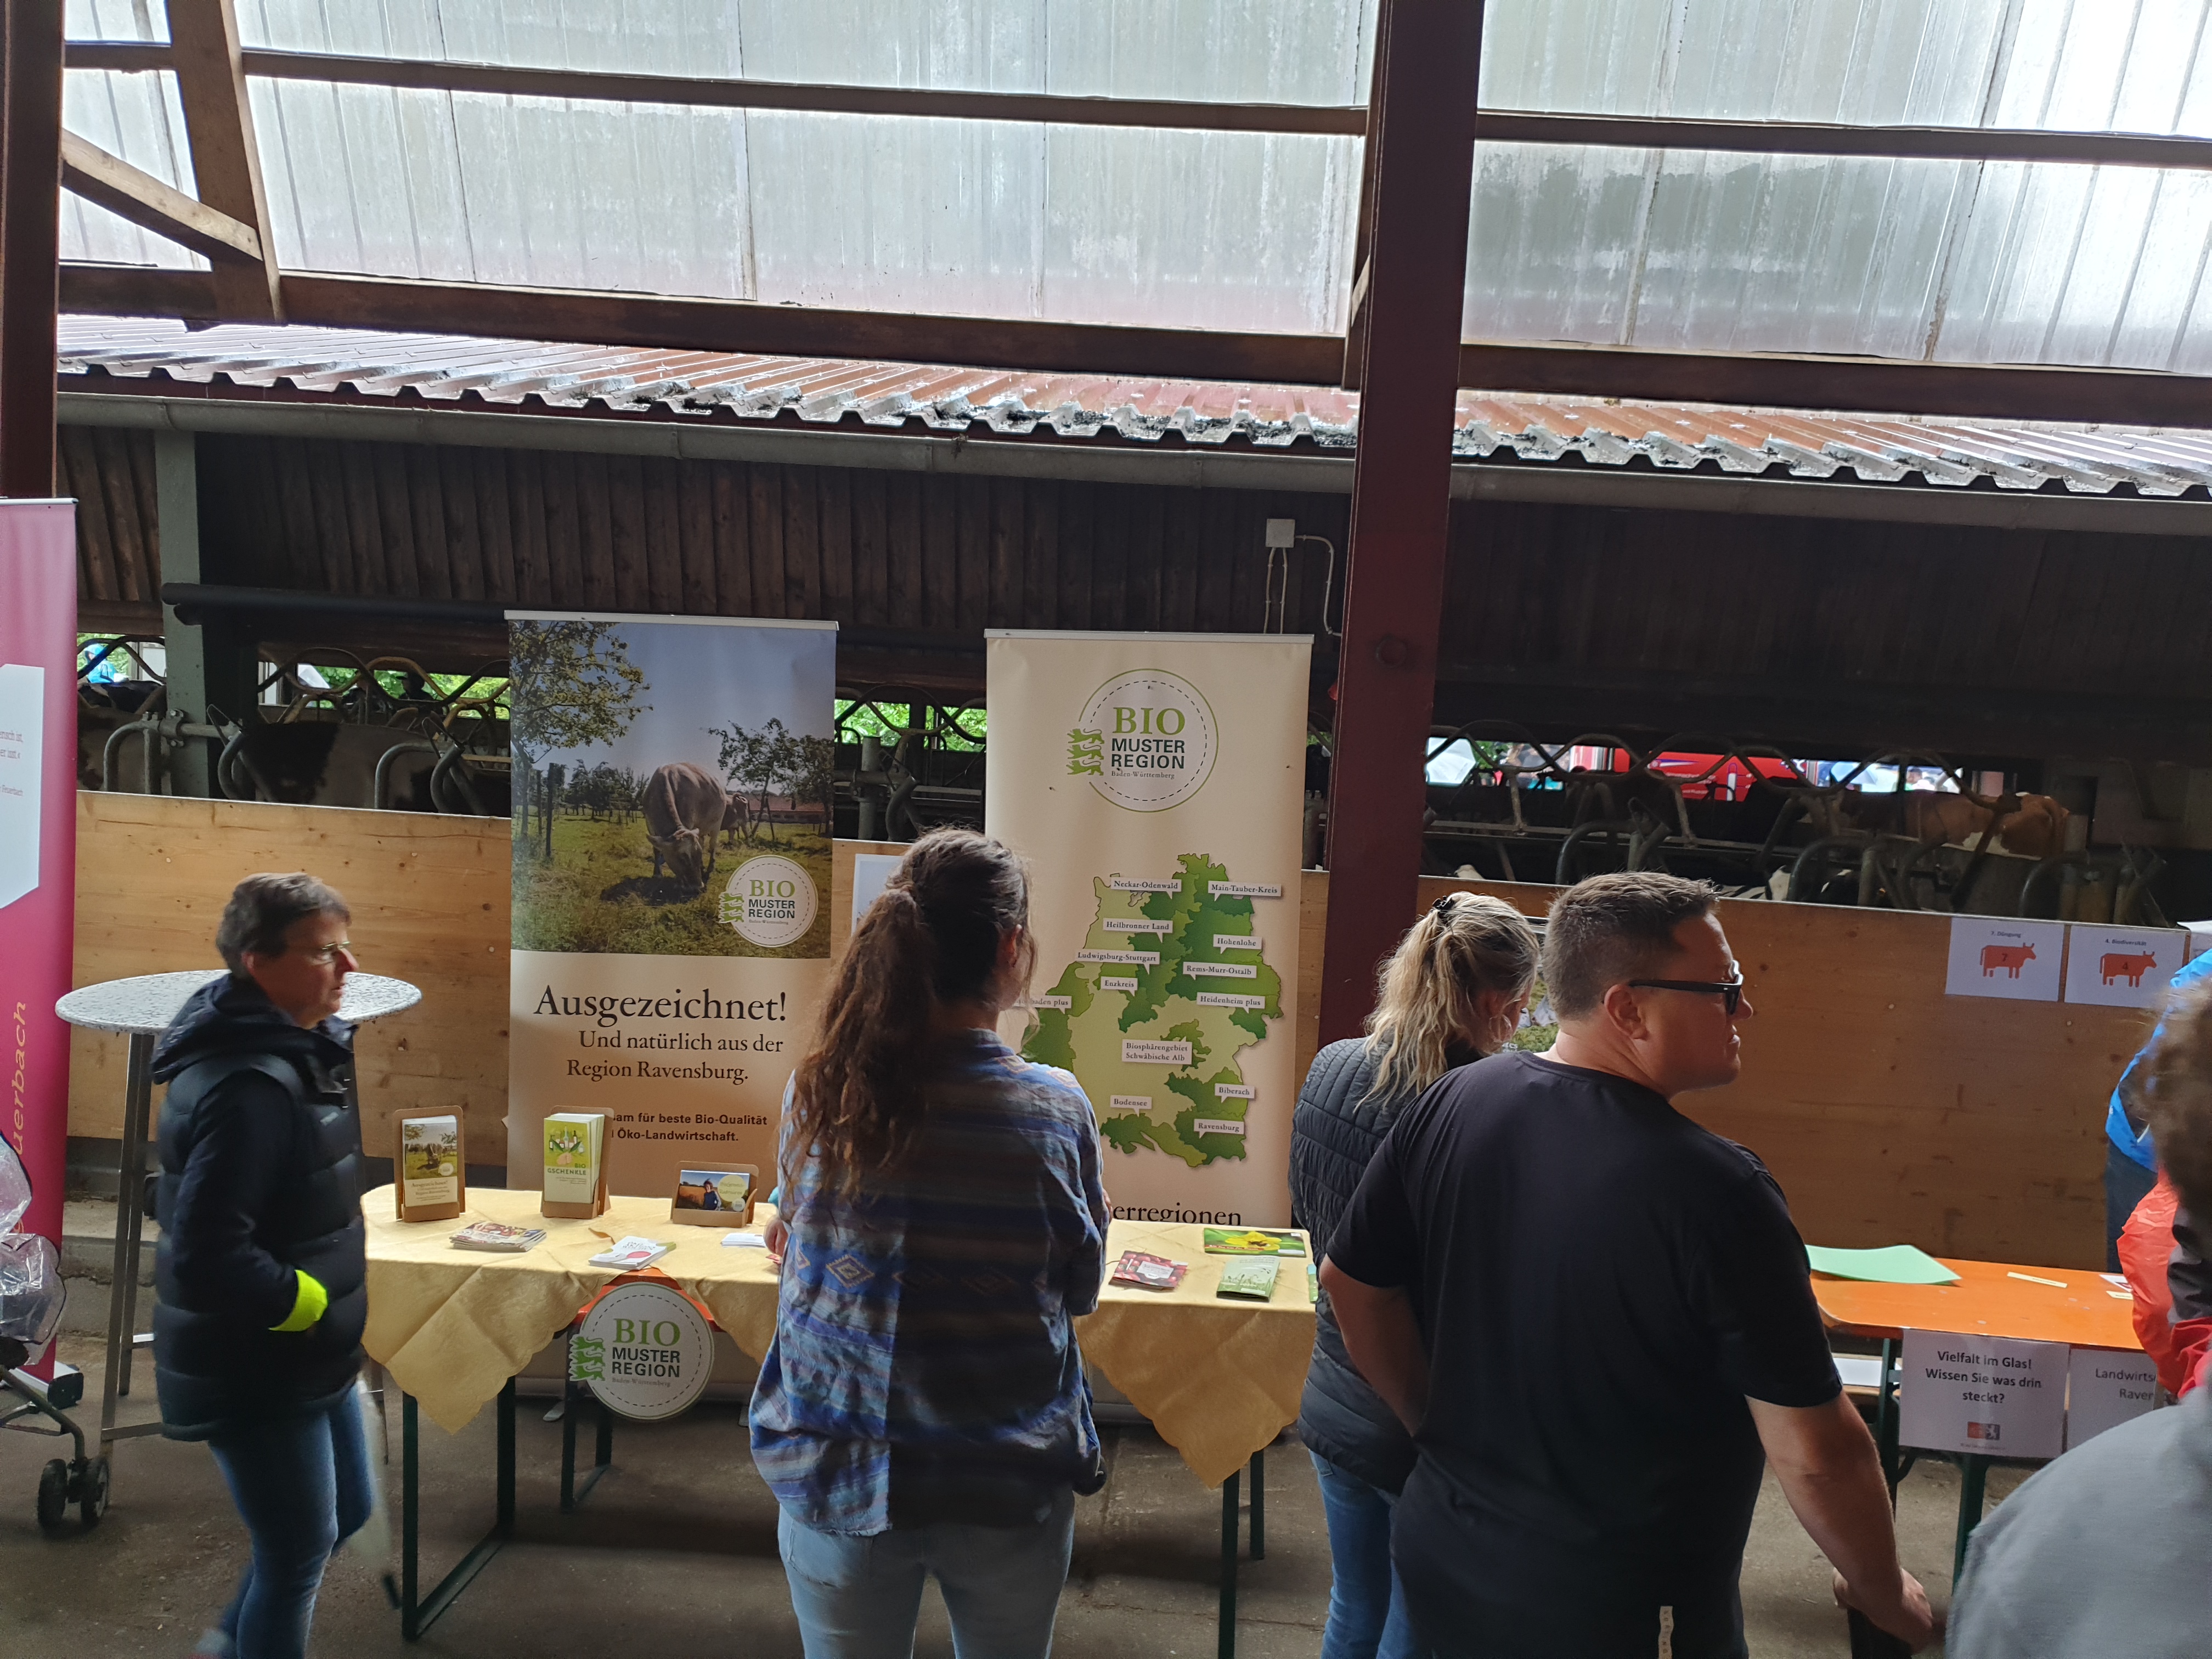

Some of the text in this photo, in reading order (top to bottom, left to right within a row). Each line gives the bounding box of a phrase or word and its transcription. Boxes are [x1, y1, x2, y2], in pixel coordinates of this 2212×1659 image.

[1112, 707, 1185, 735] BIO
[1111, 738, 1185, 753] MUSTER
[1111, 754, 1184, 769] REGION
[1111, 770, 1175, 780] Baden-Württemberg
[749, 880, 795, 898] BIO
[1114, 881, 1178, 889] Neckar-Odenwald
[1212, 884, 1278, 894] Main-Tauber-Kreis
[749, 899, 795, 909] MUSTER
[749, 909, 795, 918] REGION
[1107, 921, 1150, 930] Heilbronner
[1217, 938, 1256, 946] Hohenlohe
[1078, 952, 1156, 962] Ludwigsburg-Stuttgart
[2002, 953, 2007, 961] 7
[1187, 966, 1251, 975] Rems-Murr-Ostalb
[2122, 962, 2128, 970] 4
[1200, 995, 1243, 1005] Heidenheim
[533, 985, 786, 1028] Ausgezeichnet!
[579, 1030, 783, 1053] Und natürlich aus der
[1126, 1042, 1188, 1052] Biosphärengebiet
[1126, 1052, 1169, 1060] Schwäbische
[567, 1059, 748, 1085] Region Ravensburg.
[1218, 1087, 1249, 1096] Biberach
[638, 1113, 654, 1122] für
[659, 1113, 691, 1123] beste
[695, 1114, 767, 1125] Bio-Qualität
[1198, 1122, 1239, 1132] Ravensburg
[617, 1127, 738, 1141] Öko-Landwirtschaft.
[613, 1318, 680, 1346] BIO
[612, 1347, 680, 1363] MUSTER
[1937, 1351, 2032, 1369] Vielfalt im Glas!
[612, 1362, 680, 1378] REGION
[1926, 1368, 2041, 1389] Wissen Sie was drin
[1962, 1391, 2005, 1404] steckt?
